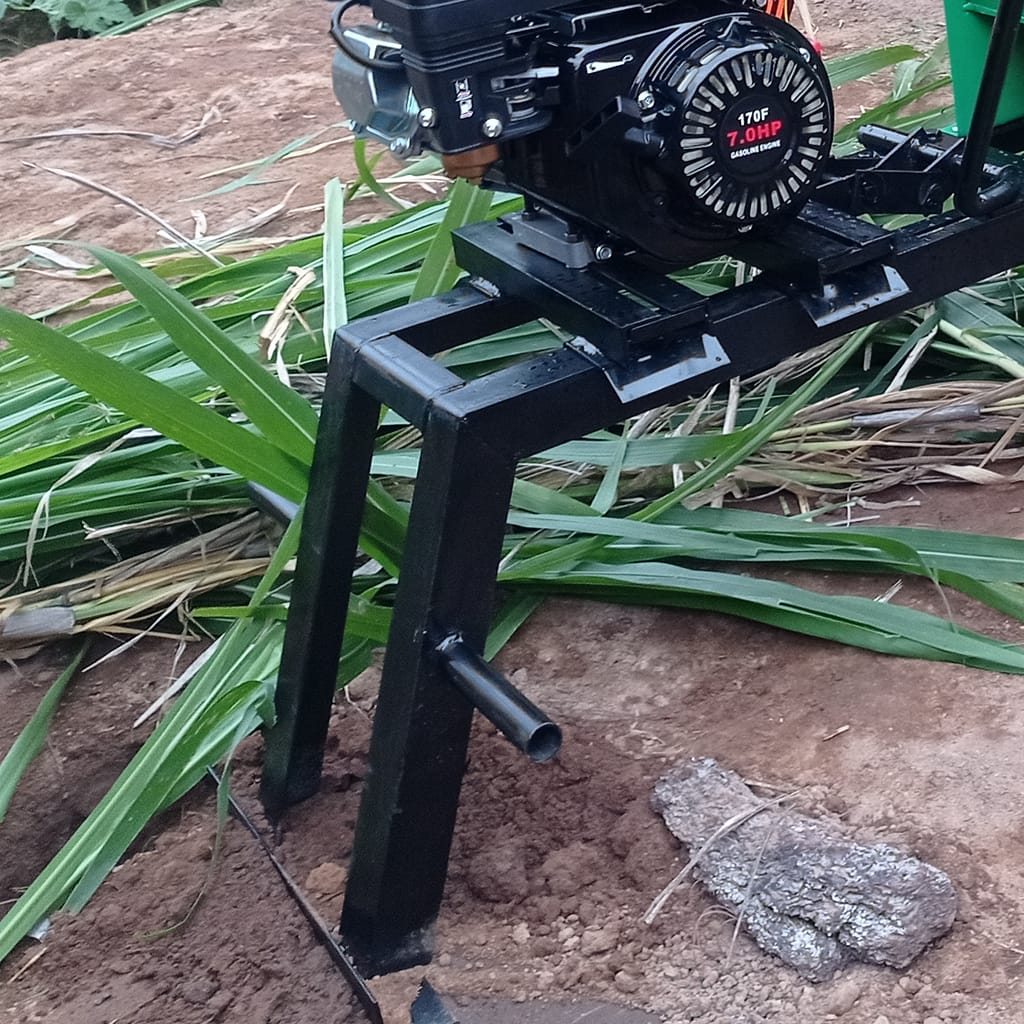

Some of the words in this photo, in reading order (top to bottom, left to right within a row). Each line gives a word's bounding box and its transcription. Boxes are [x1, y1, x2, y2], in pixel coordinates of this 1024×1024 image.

[738, 107, 769, 126] 170F
[727, 120, 782, 147] 7.0HP
[730, 145, 759, 159] GASOLINE
[759, 139, 781, 152] ENGINE
